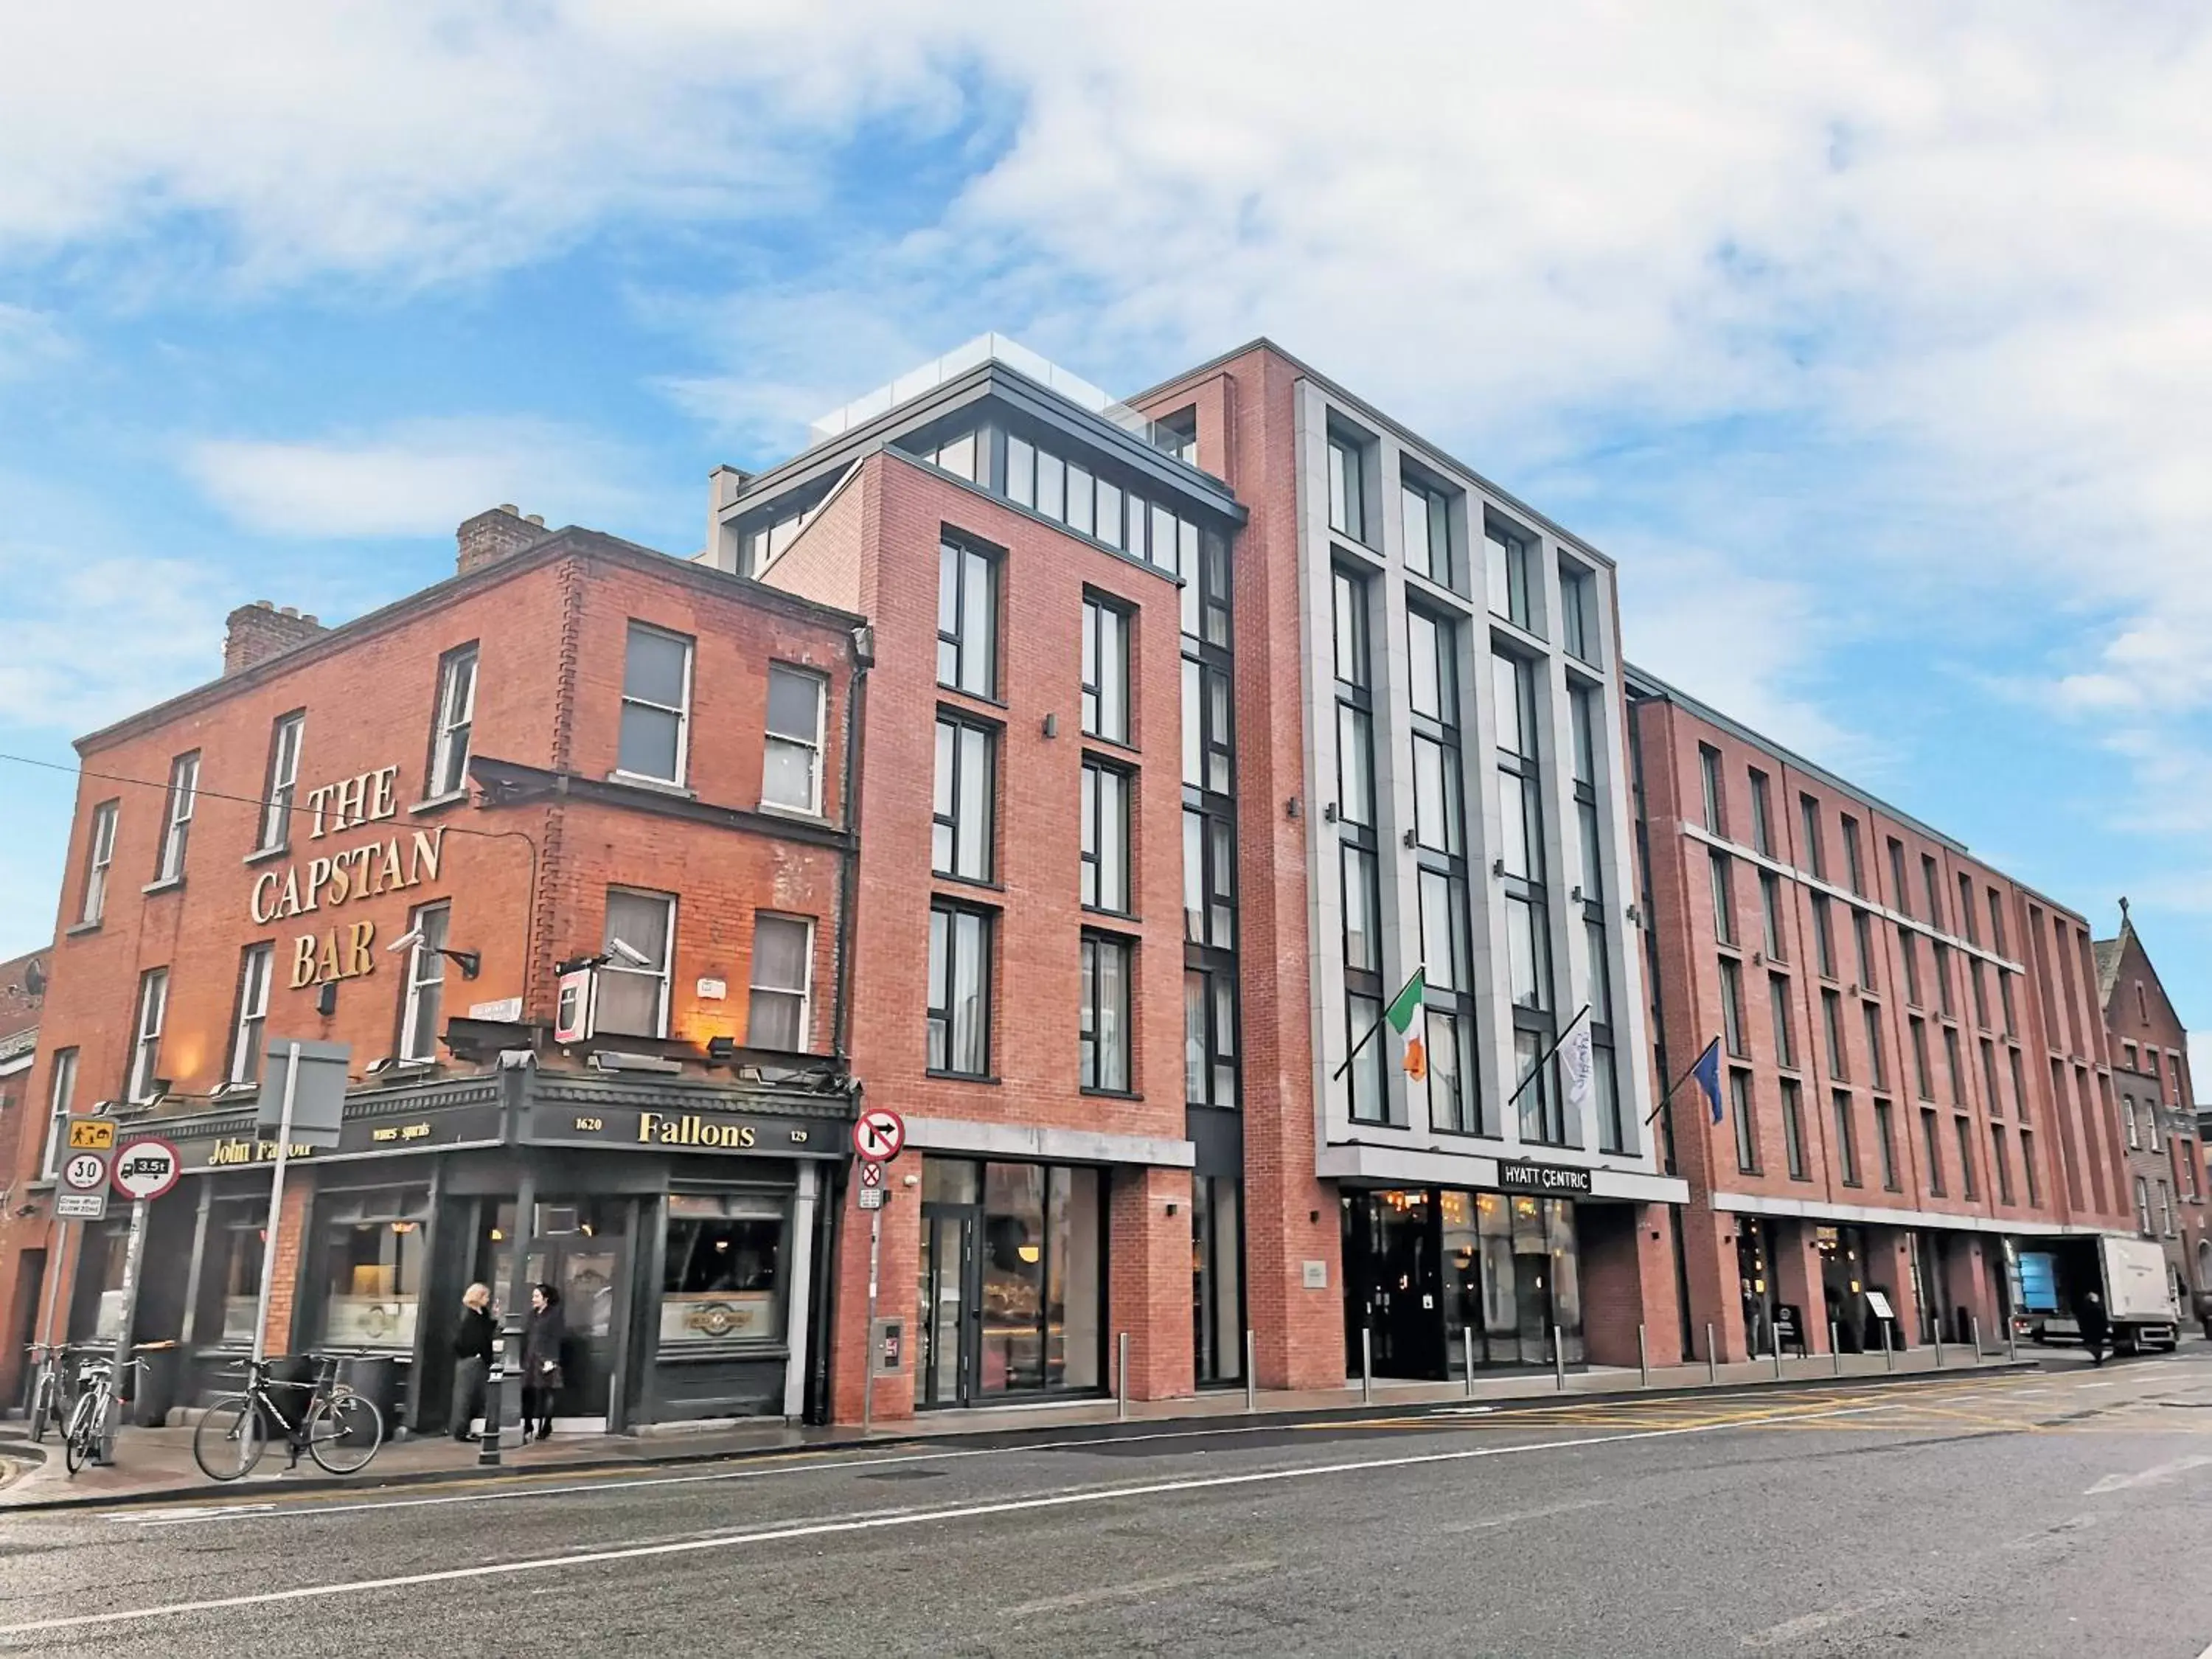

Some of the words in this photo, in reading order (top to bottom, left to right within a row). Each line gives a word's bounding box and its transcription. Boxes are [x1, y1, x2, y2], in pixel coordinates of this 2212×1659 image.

[307, 765, 398, 839] THE
[251, 824, 446, 924] CAPSTAN
[287, 919, 375, 990] BAR
[576, 1118, 602, 1131] 1620
[637, 1111, 756, 1147] Fallons
[790, 1130, 807, 1142] 129
[208, 1137, 250, 1165] John
[255, 1141, 311, 1161] Faon
[74, 1161, 97, 1178] 30
[138, 1160, 166, 1172] 3.5t
[1505, 1166, 1540, 1183] HYATT
[1542, 1169, 1588, 1189] CENTRIC
